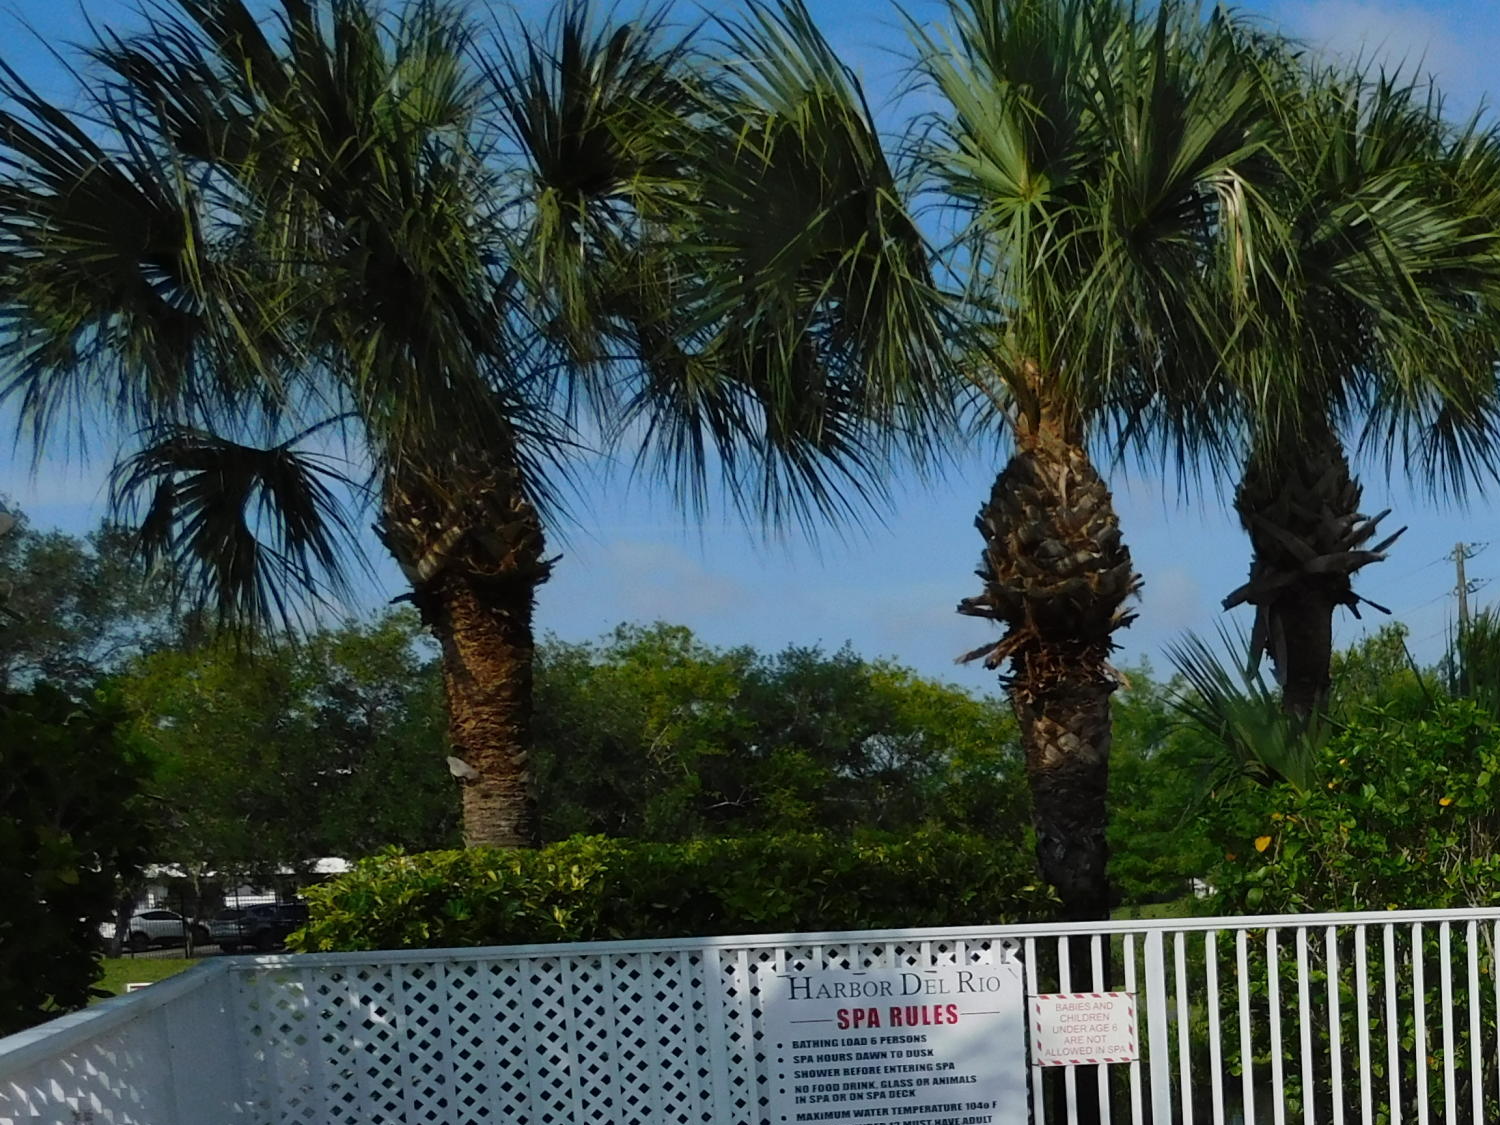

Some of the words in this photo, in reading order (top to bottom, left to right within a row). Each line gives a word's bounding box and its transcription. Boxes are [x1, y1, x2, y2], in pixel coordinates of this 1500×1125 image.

[789, 977, 892, 1000] HARBOR
[1056, 1002, 1090, 1011] BABIES
[1093, 1002, 1113, 1010] AND
[837, 1008, 880, 1030] SPA
[890, 1004, 958, 1027] RULES
[1060, 1013, 1109, 1022] CHILDREN
[1053, 1025, 1087, 1033] UNDER
[1089, 1024, 1109, 1032] AGE
[792, 1039, 838, 1049] BATHING
[842, 1038, 868, 1047] LOAD
[871, 1037, 877, 1045] 6
[880, 1035, 927, 1045] PERSONS
[1064, 1036, 1085, 1045] ARE
[1087, 1035, 1106, 1043] NOT
[793, 1055, 813, 1063] SPA
[817, 1053, 852, 1062] HOURS
[856, 1051, 887, 1060] DAWN
[891, 1050, 903, 1059] TO
[906, 1049, 934, 1058] DUSK
[1045, 1047, 1092, 1056] ALLOWED
[1108, 1045, 1126, 1053] SPA
[794, 1069, 840, 1079] SHOWER
[843, 1066, 881, 1076] BEFORE
[884, 1063, 933, 1074] ENTERING
[936, 1062, 955, 1071] SPA
[795, 1085, 809, 1093] NO
[812, 1083, 839, 1092] FOOD
[881, 1079, 913, 1088] GLASS
[916, 1078, 929, 1086] OR
[933, 1075, 976, 1085] ANIMALS
[795, 1096, 807, 1104] IN
[809, 1095, 829, 1103] SPA
[832, 1094, 846, 1102] OR
[850, 1093, 862, 1101] ON
[866, 1091, 886, 1100] SPA
[889, 1089, 916, 1098] DECK
[797, 1110, 850, 1121] MAXIMUM
[853, 1108, 889, 1118] WATER
[892, 1103, 963, 1115] TEMPERATURE
[992, 1101, 997, 1109] F
[962, 1116, 992, 1125] ADULT
